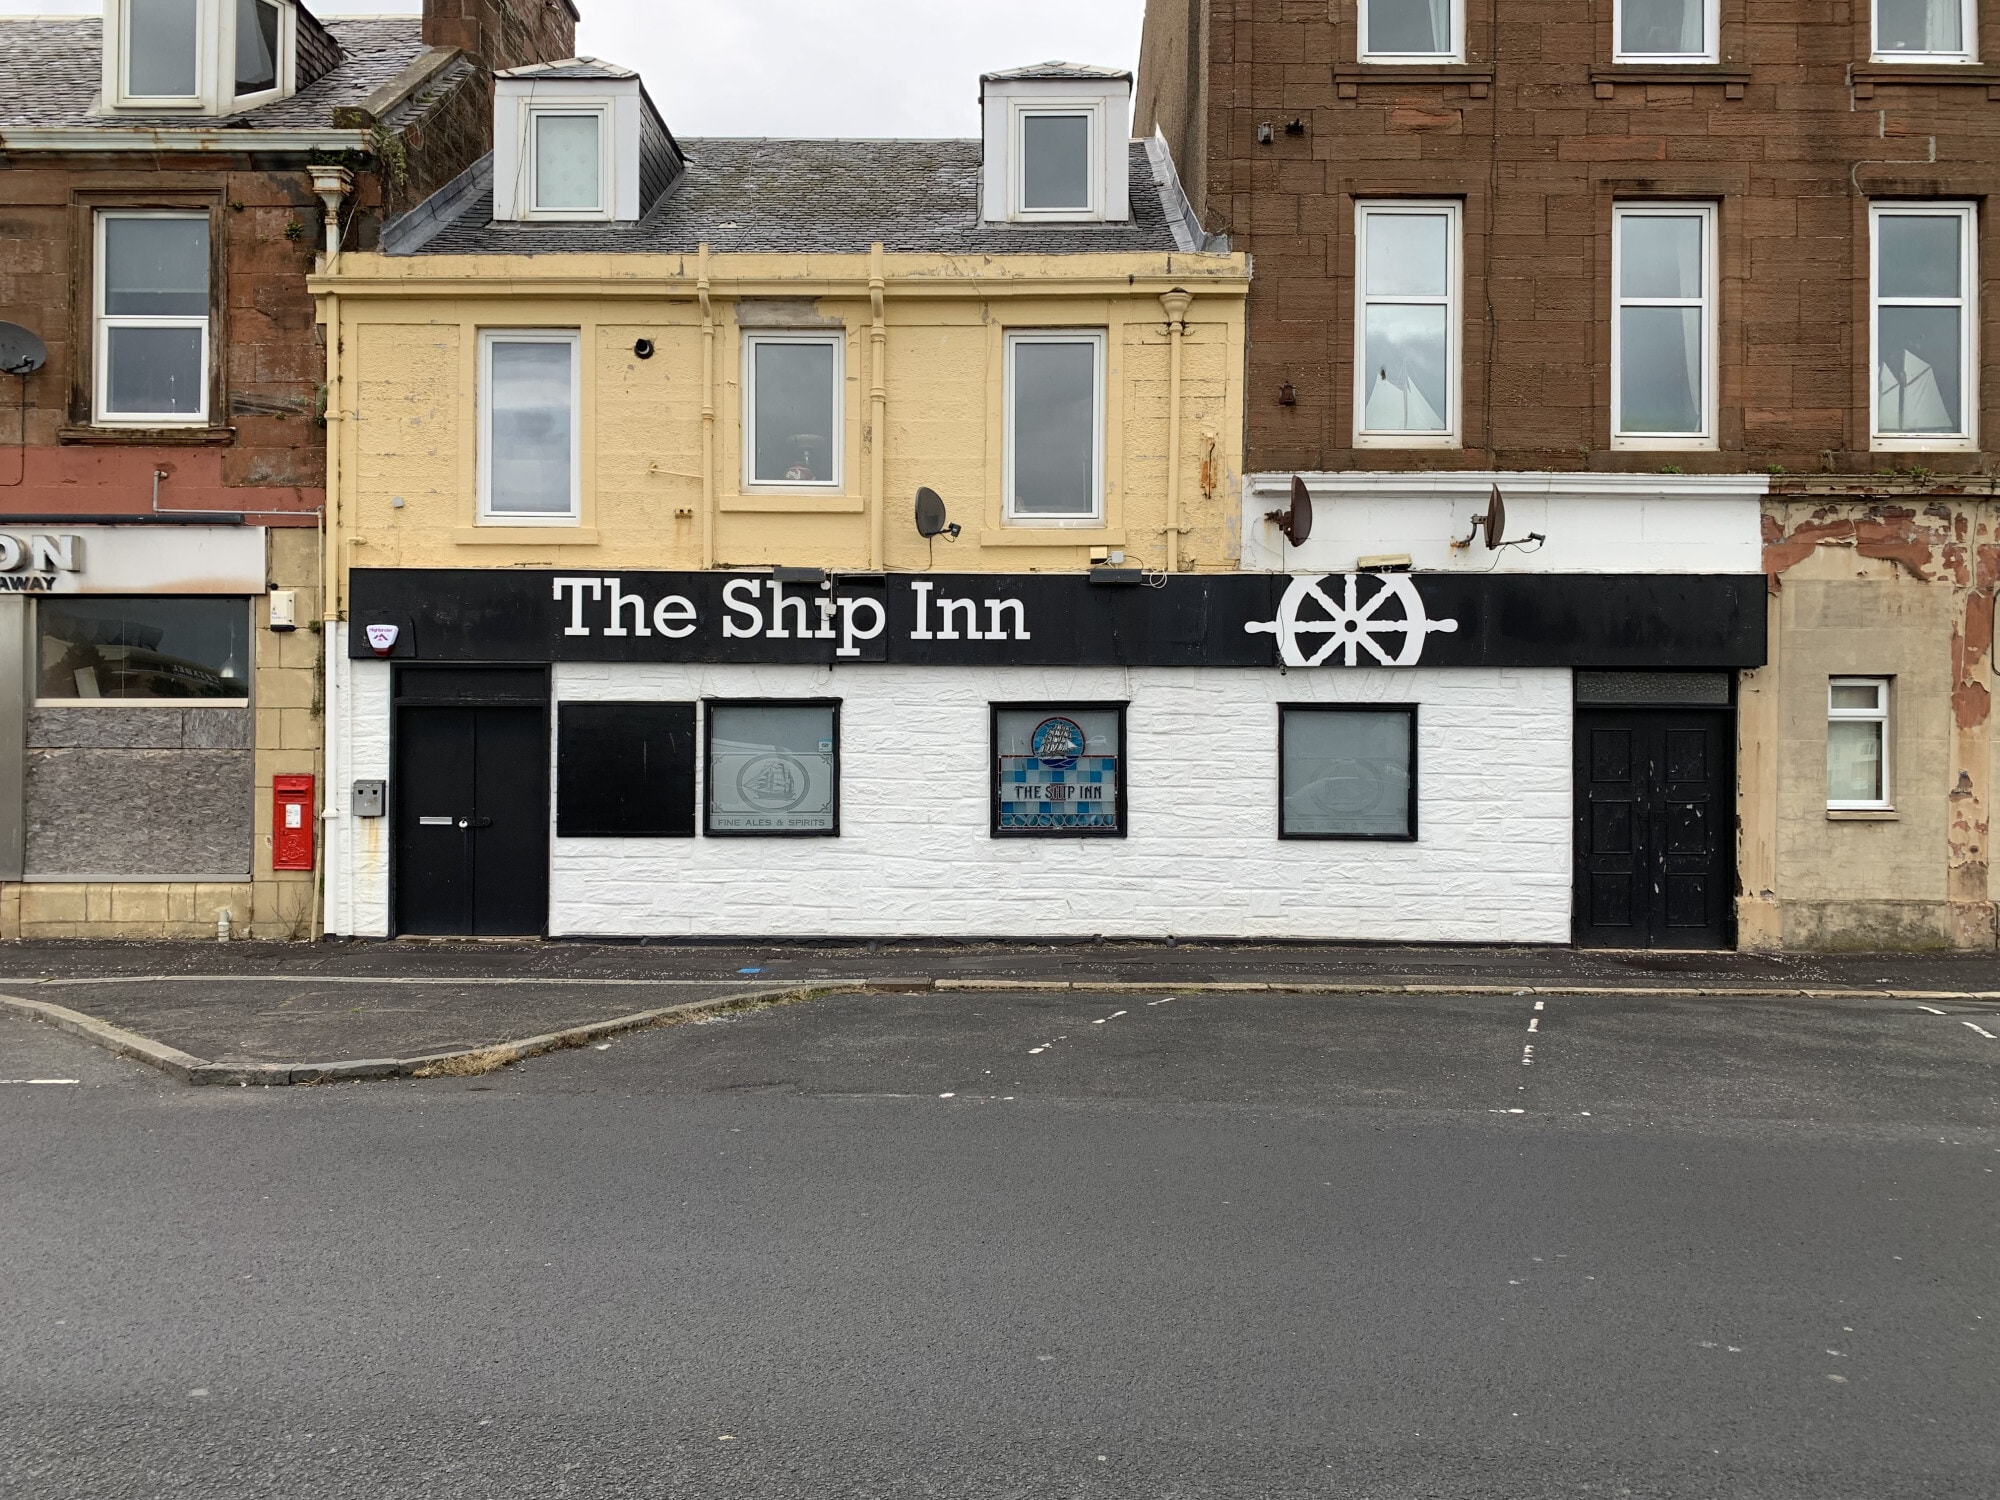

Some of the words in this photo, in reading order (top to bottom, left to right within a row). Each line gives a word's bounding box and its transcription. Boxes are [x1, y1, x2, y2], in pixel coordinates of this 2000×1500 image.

[553, 577, 698, 638] The
[721, 578, 886, 656] Ship
[909, 581, 1031, 640] Inn
[1014, 785, 1042, 800] THE
[1045, 785, 1075, 800] SHIP
[1080, 785, 1102, 800] INN
[717, 819, 741, 827] FINE
[745, 819, 772, 827] ALES
[776, 819, 784, 827] &
[788, 819, 826, 827] SPIRITS
